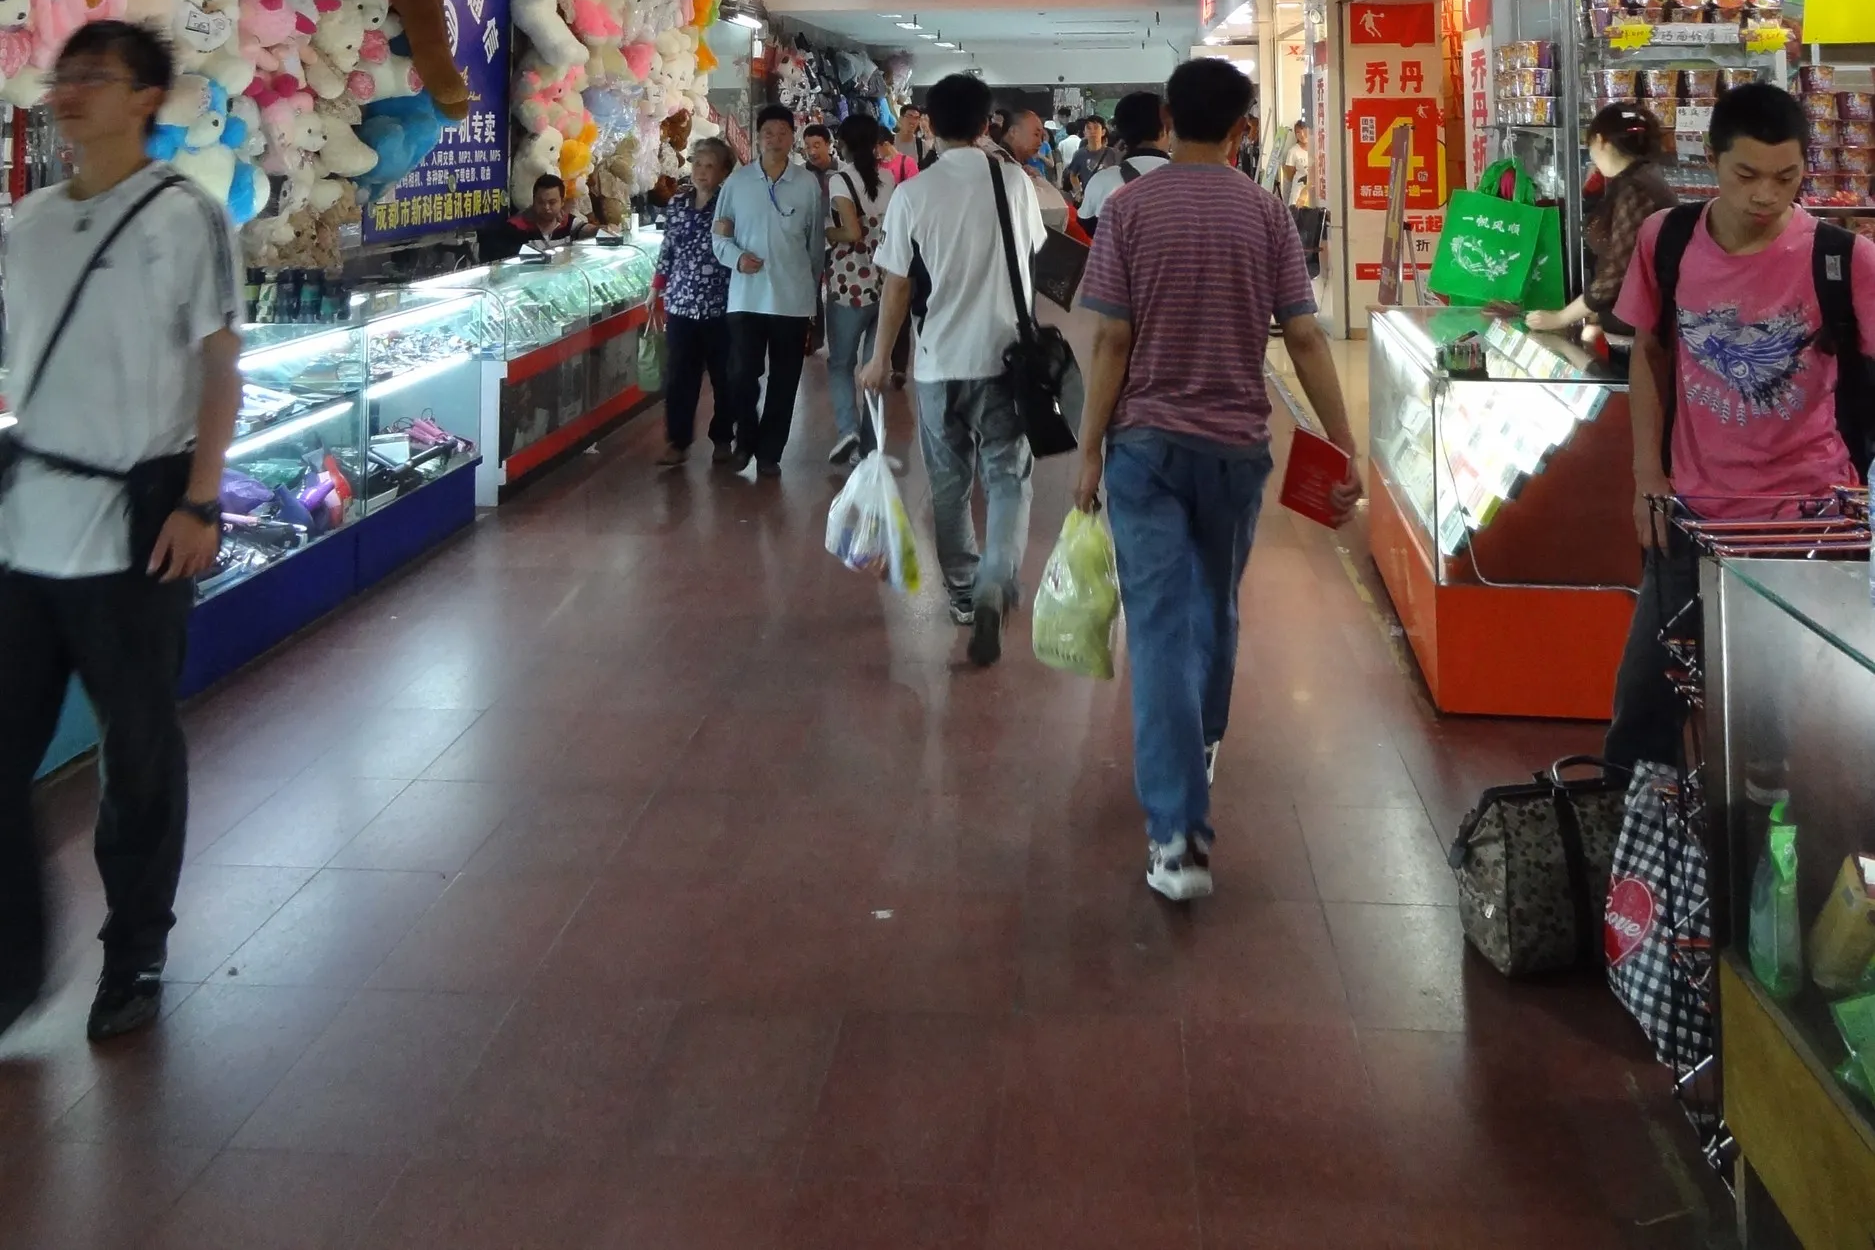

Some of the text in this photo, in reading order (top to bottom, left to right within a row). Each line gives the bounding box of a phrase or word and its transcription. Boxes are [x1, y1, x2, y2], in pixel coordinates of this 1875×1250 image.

[1365, 61, 1423, 94] 乔丹
[1470, 49, 1488, 190] 乔丹折
[1367, 117, 1425, 181] 4
[374, 188, 500, 231] 成都市新科信通讯有限公司
[1461, 214, 1520, 235] 一帆风顺
[1416, 239, 1431, 252] 折
